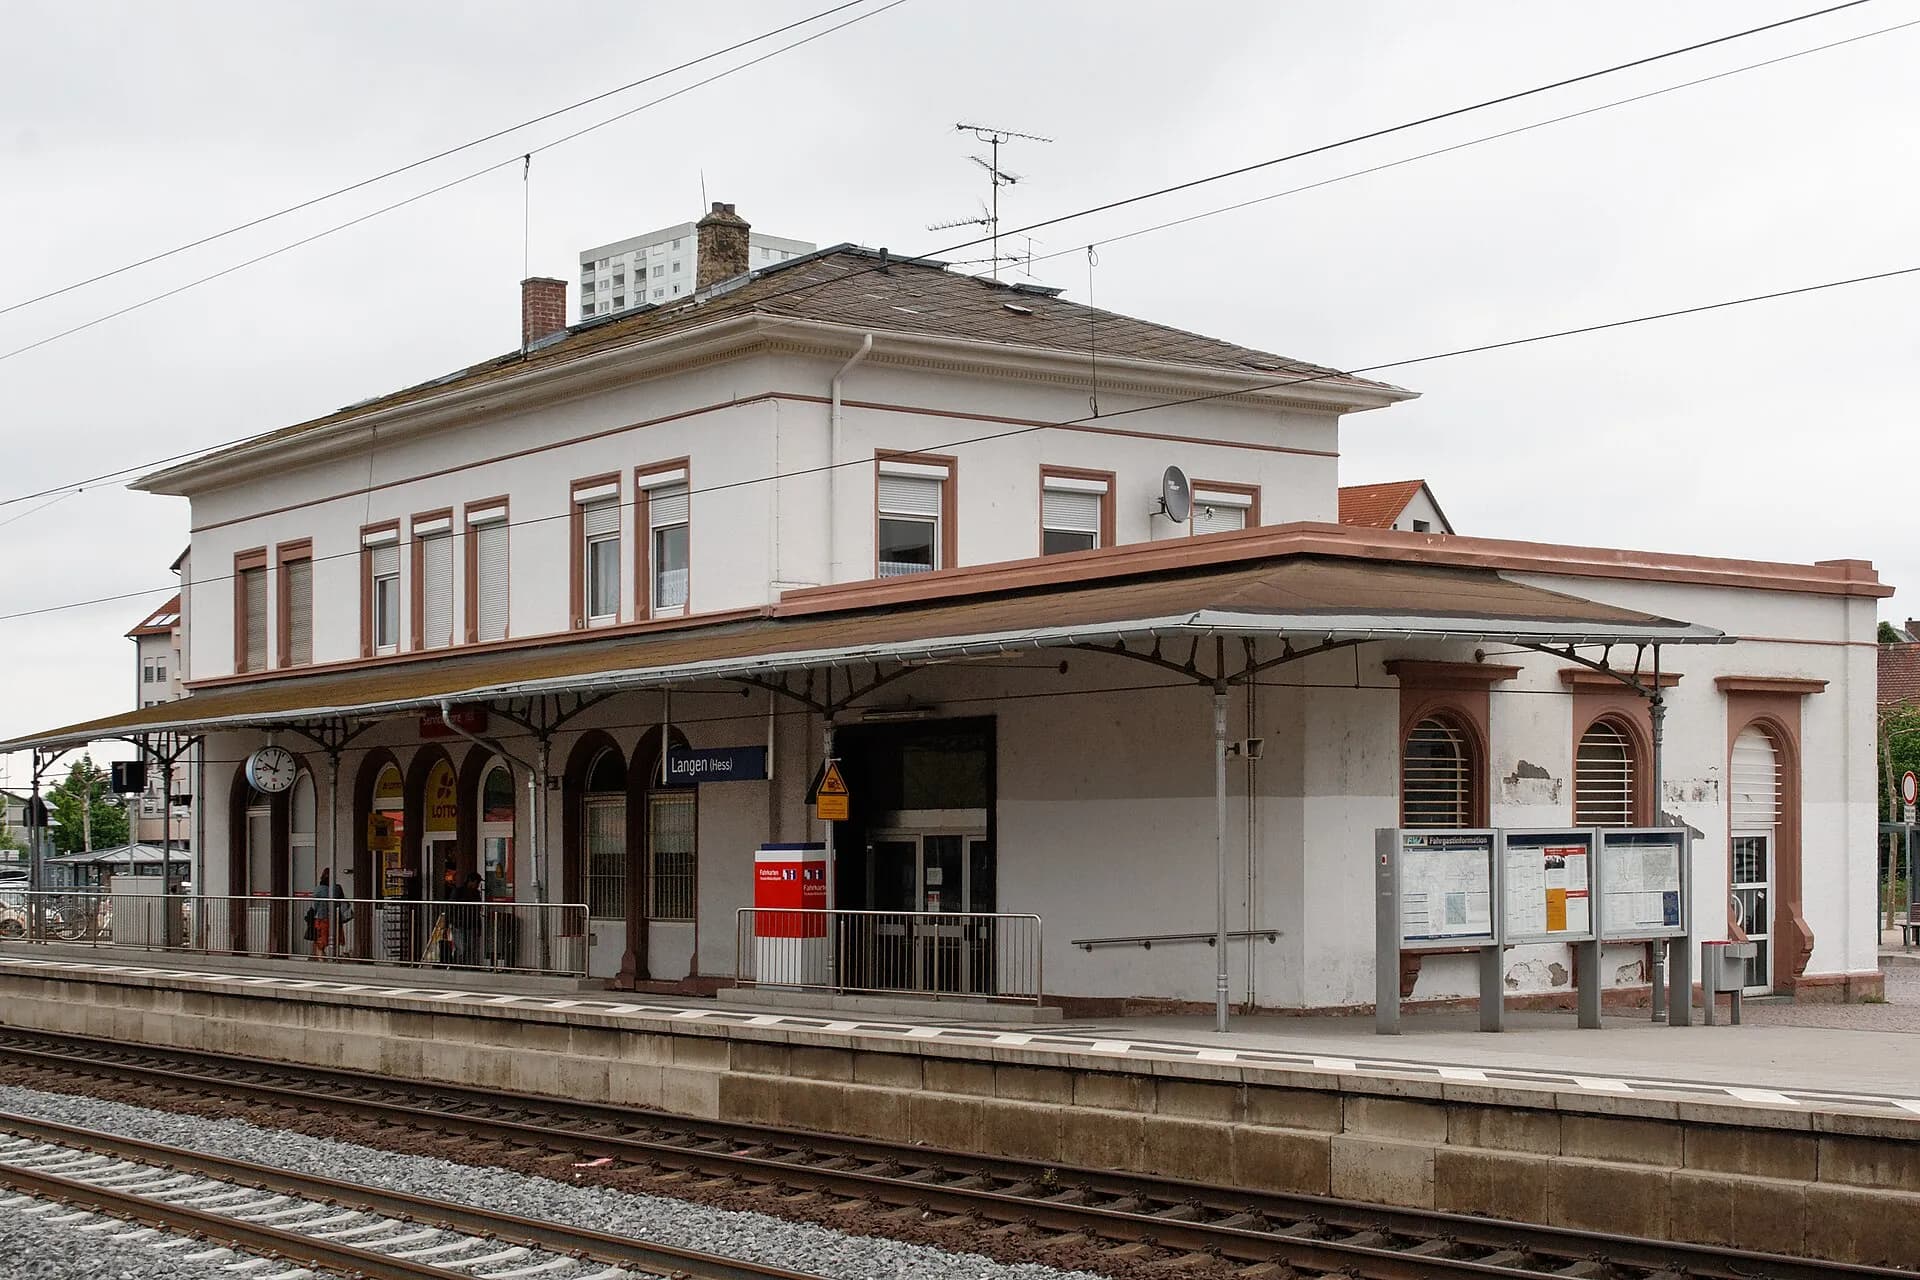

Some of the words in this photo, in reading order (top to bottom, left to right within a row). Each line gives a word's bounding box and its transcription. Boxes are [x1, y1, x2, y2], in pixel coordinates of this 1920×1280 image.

[116, 763, 128, 786] 1
[671, 757, 707, 776] Langen
[709, 757, 733, 771] (Hess)
[432, 804, 457, 819] LOTTO
[1429, 836, 1488, 845] Fahrgastinformation
